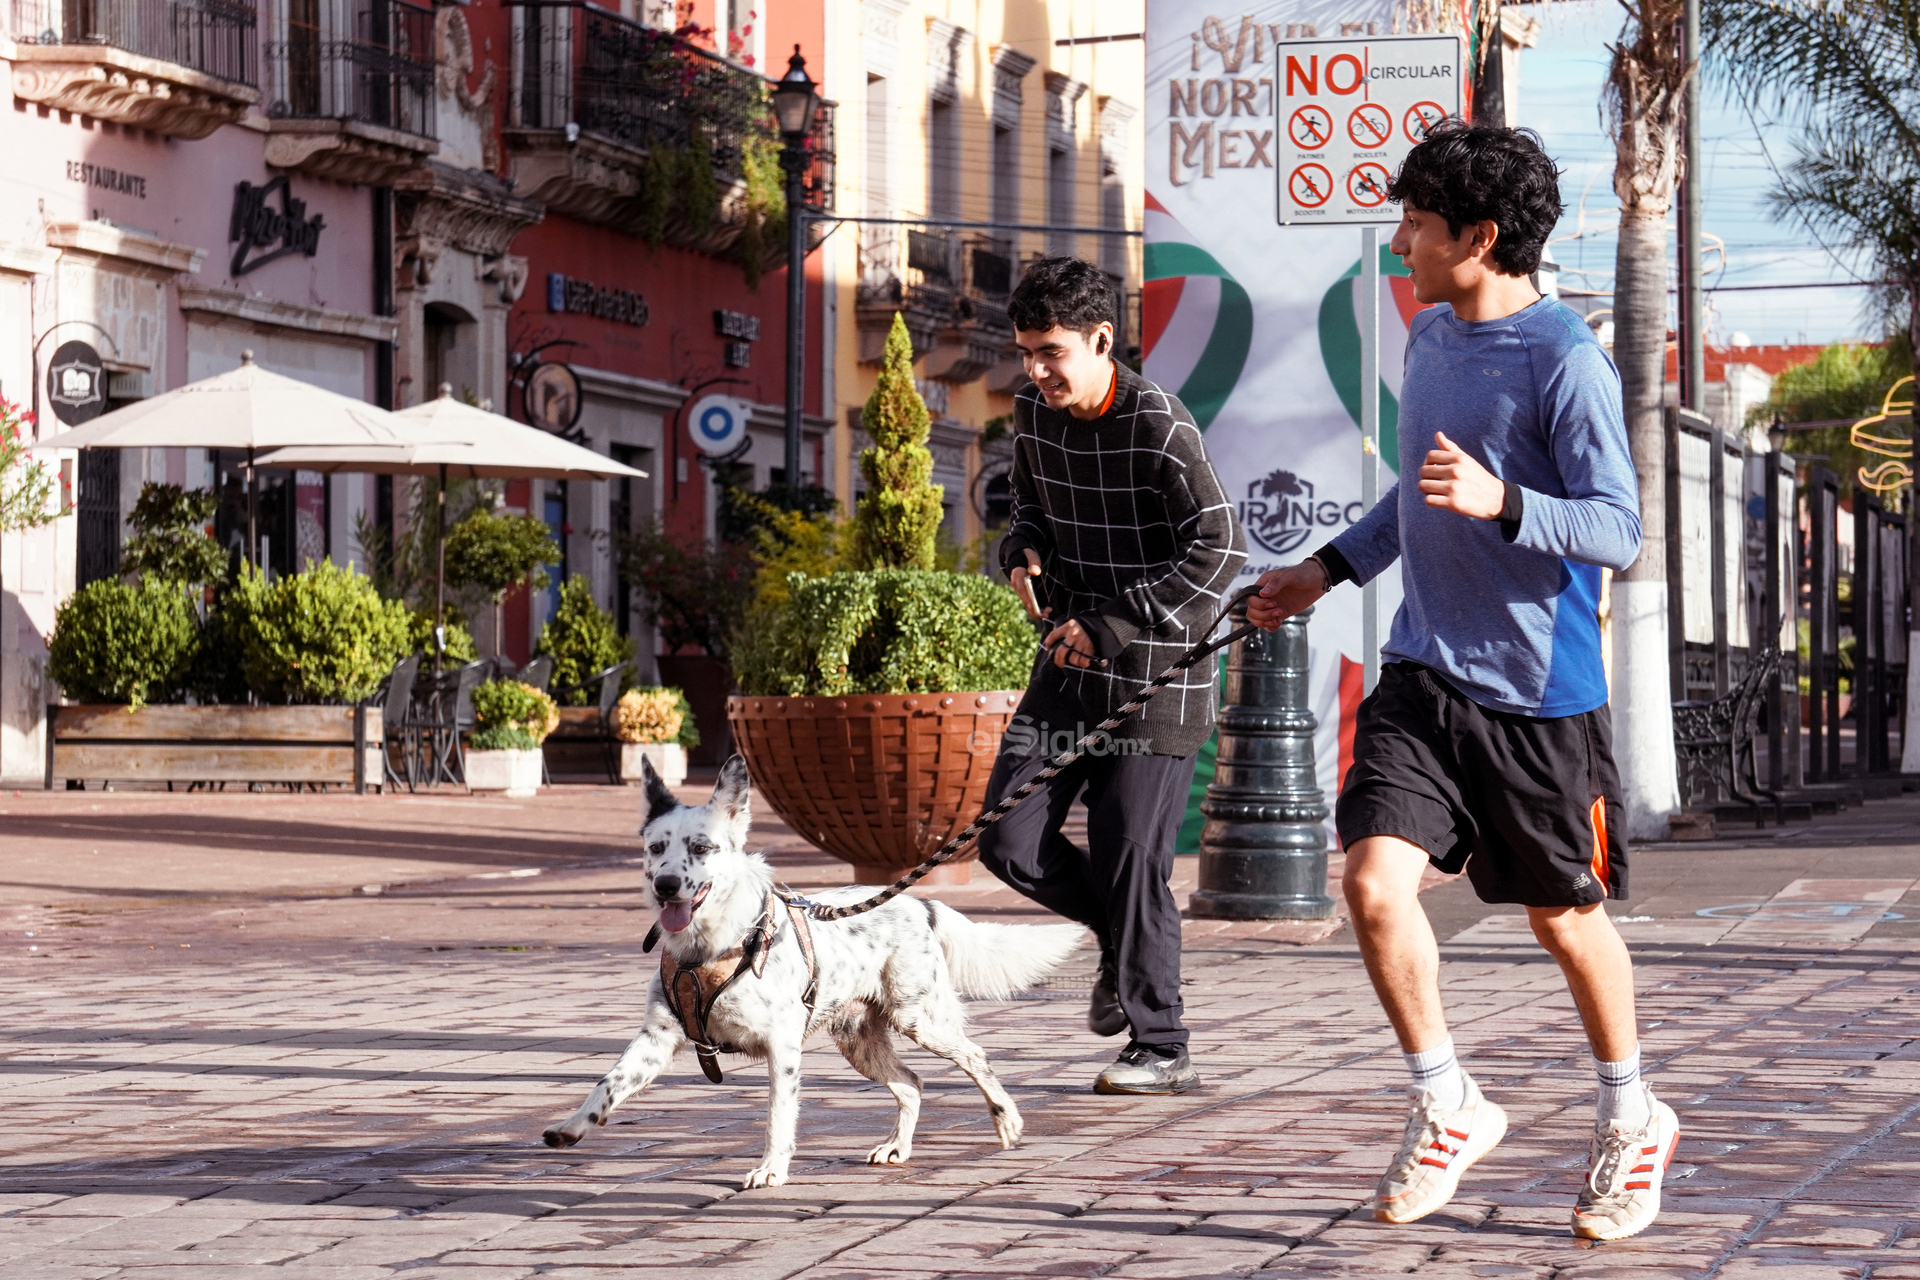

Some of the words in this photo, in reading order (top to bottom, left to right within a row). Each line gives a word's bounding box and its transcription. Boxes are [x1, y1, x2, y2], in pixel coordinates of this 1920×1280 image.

[1286, 53, 1363, 96] NO
[1370, 65, 1452, 79] CIRCULAR
[1353, 151, 1387, 159] BICICLETA
[66, 160, 147, 200] RESTAURANTE
